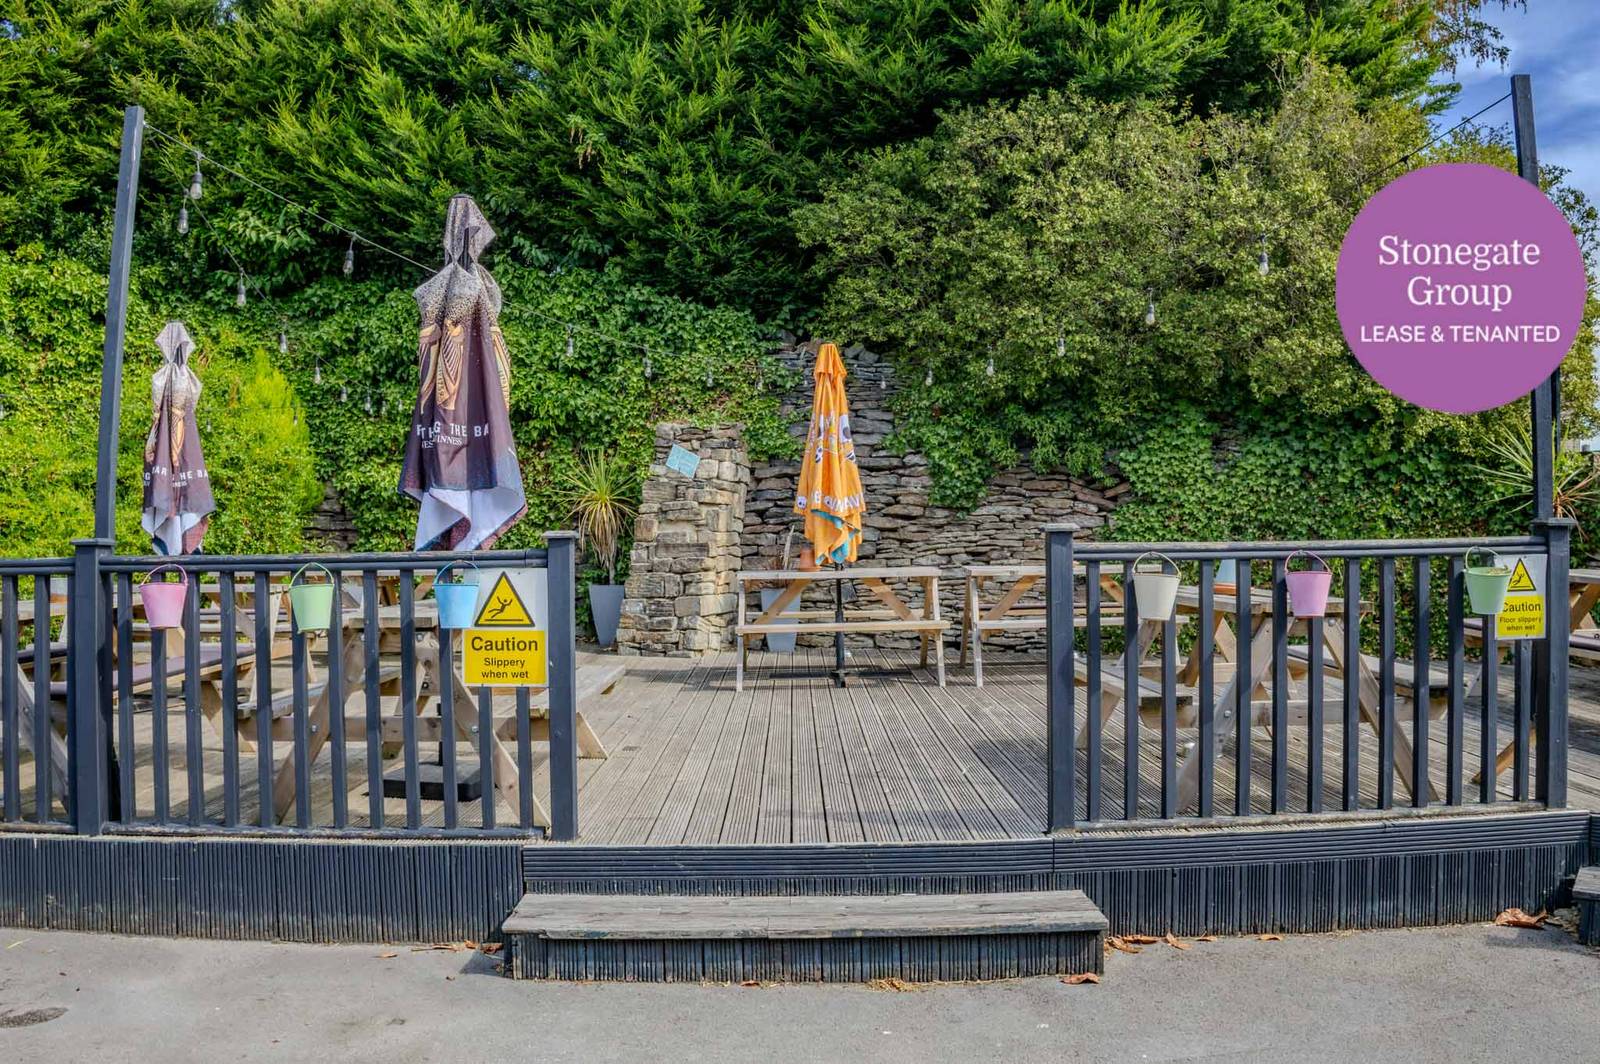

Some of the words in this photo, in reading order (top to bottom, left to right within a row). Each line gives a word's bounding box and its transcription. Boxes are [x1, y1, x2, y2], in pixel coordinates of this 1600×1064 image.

[449, 423, 468, 437] THE
[1503, 601, 1541, 612] Caution
[471, 636, 538, 652] Caution
[484, 657, 526, 668] Slippery
[481, 671, 508, 679] when
[511, 671, 529, 679] wet
